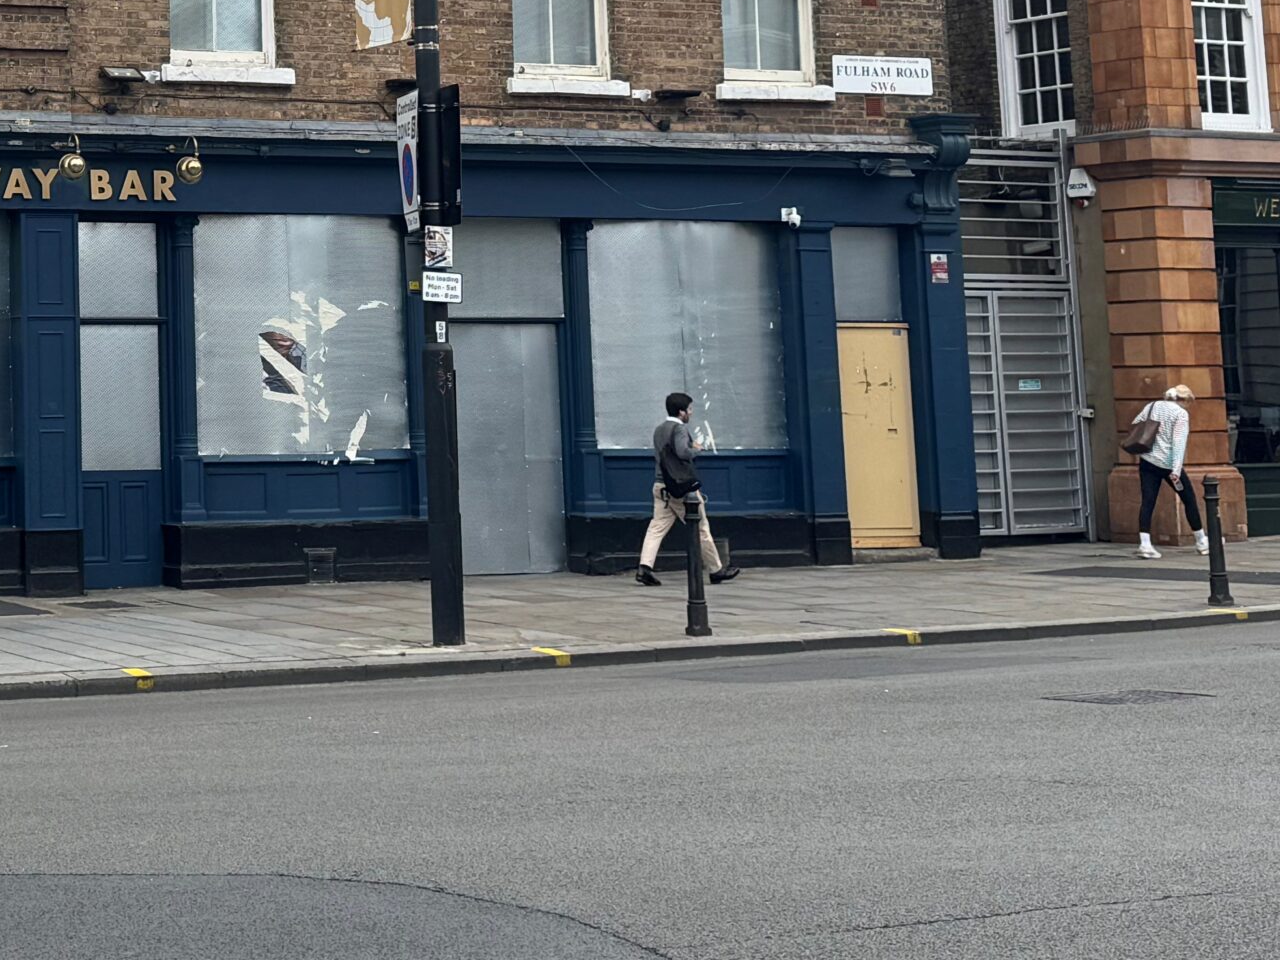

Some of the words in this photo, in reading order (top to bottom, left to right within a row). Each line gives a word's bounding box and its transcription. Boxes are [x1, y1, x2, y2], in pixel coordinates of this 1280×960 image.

[836, 65, 890, 78] FULHAM
[896, 67, 929, 78] ROAD
[870, 81, 896, 92] SW6
[89, 169, 177, 201] BAR
[436, 275, 459, 284] loading
